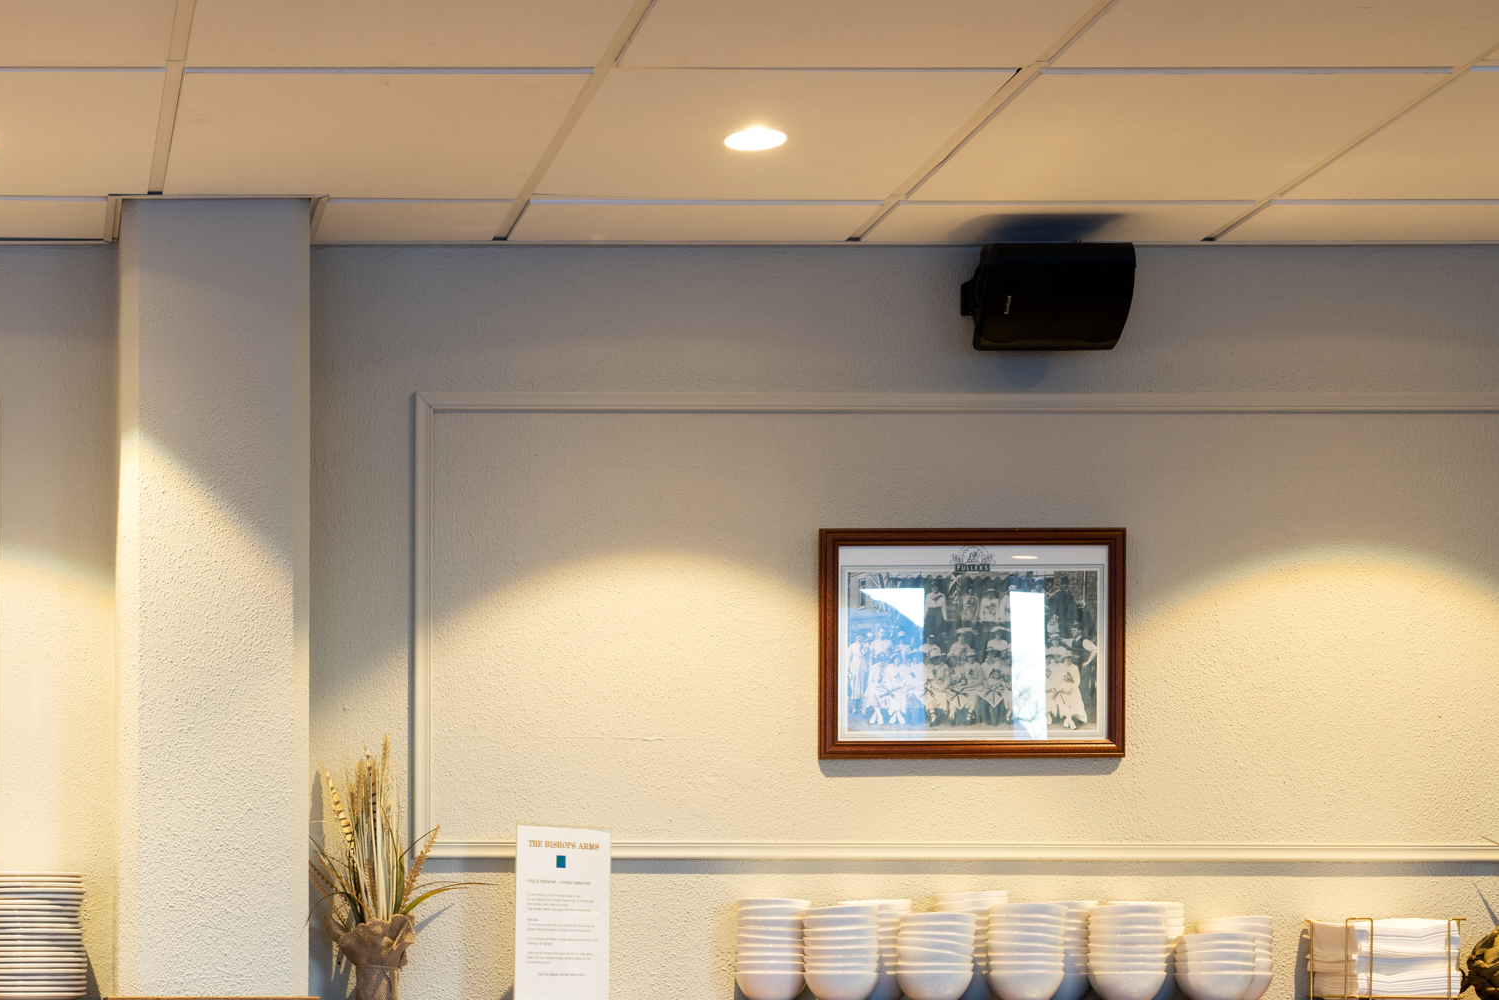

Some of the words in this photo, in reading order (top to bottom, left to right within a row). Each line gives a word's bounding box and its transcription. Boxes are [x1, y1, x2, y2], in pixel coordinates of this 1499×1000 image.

[528, 840, 543, 848] THE
[544, 840, 576, 849] BISHOPS
[578, 842, 600, 851] ARMS
